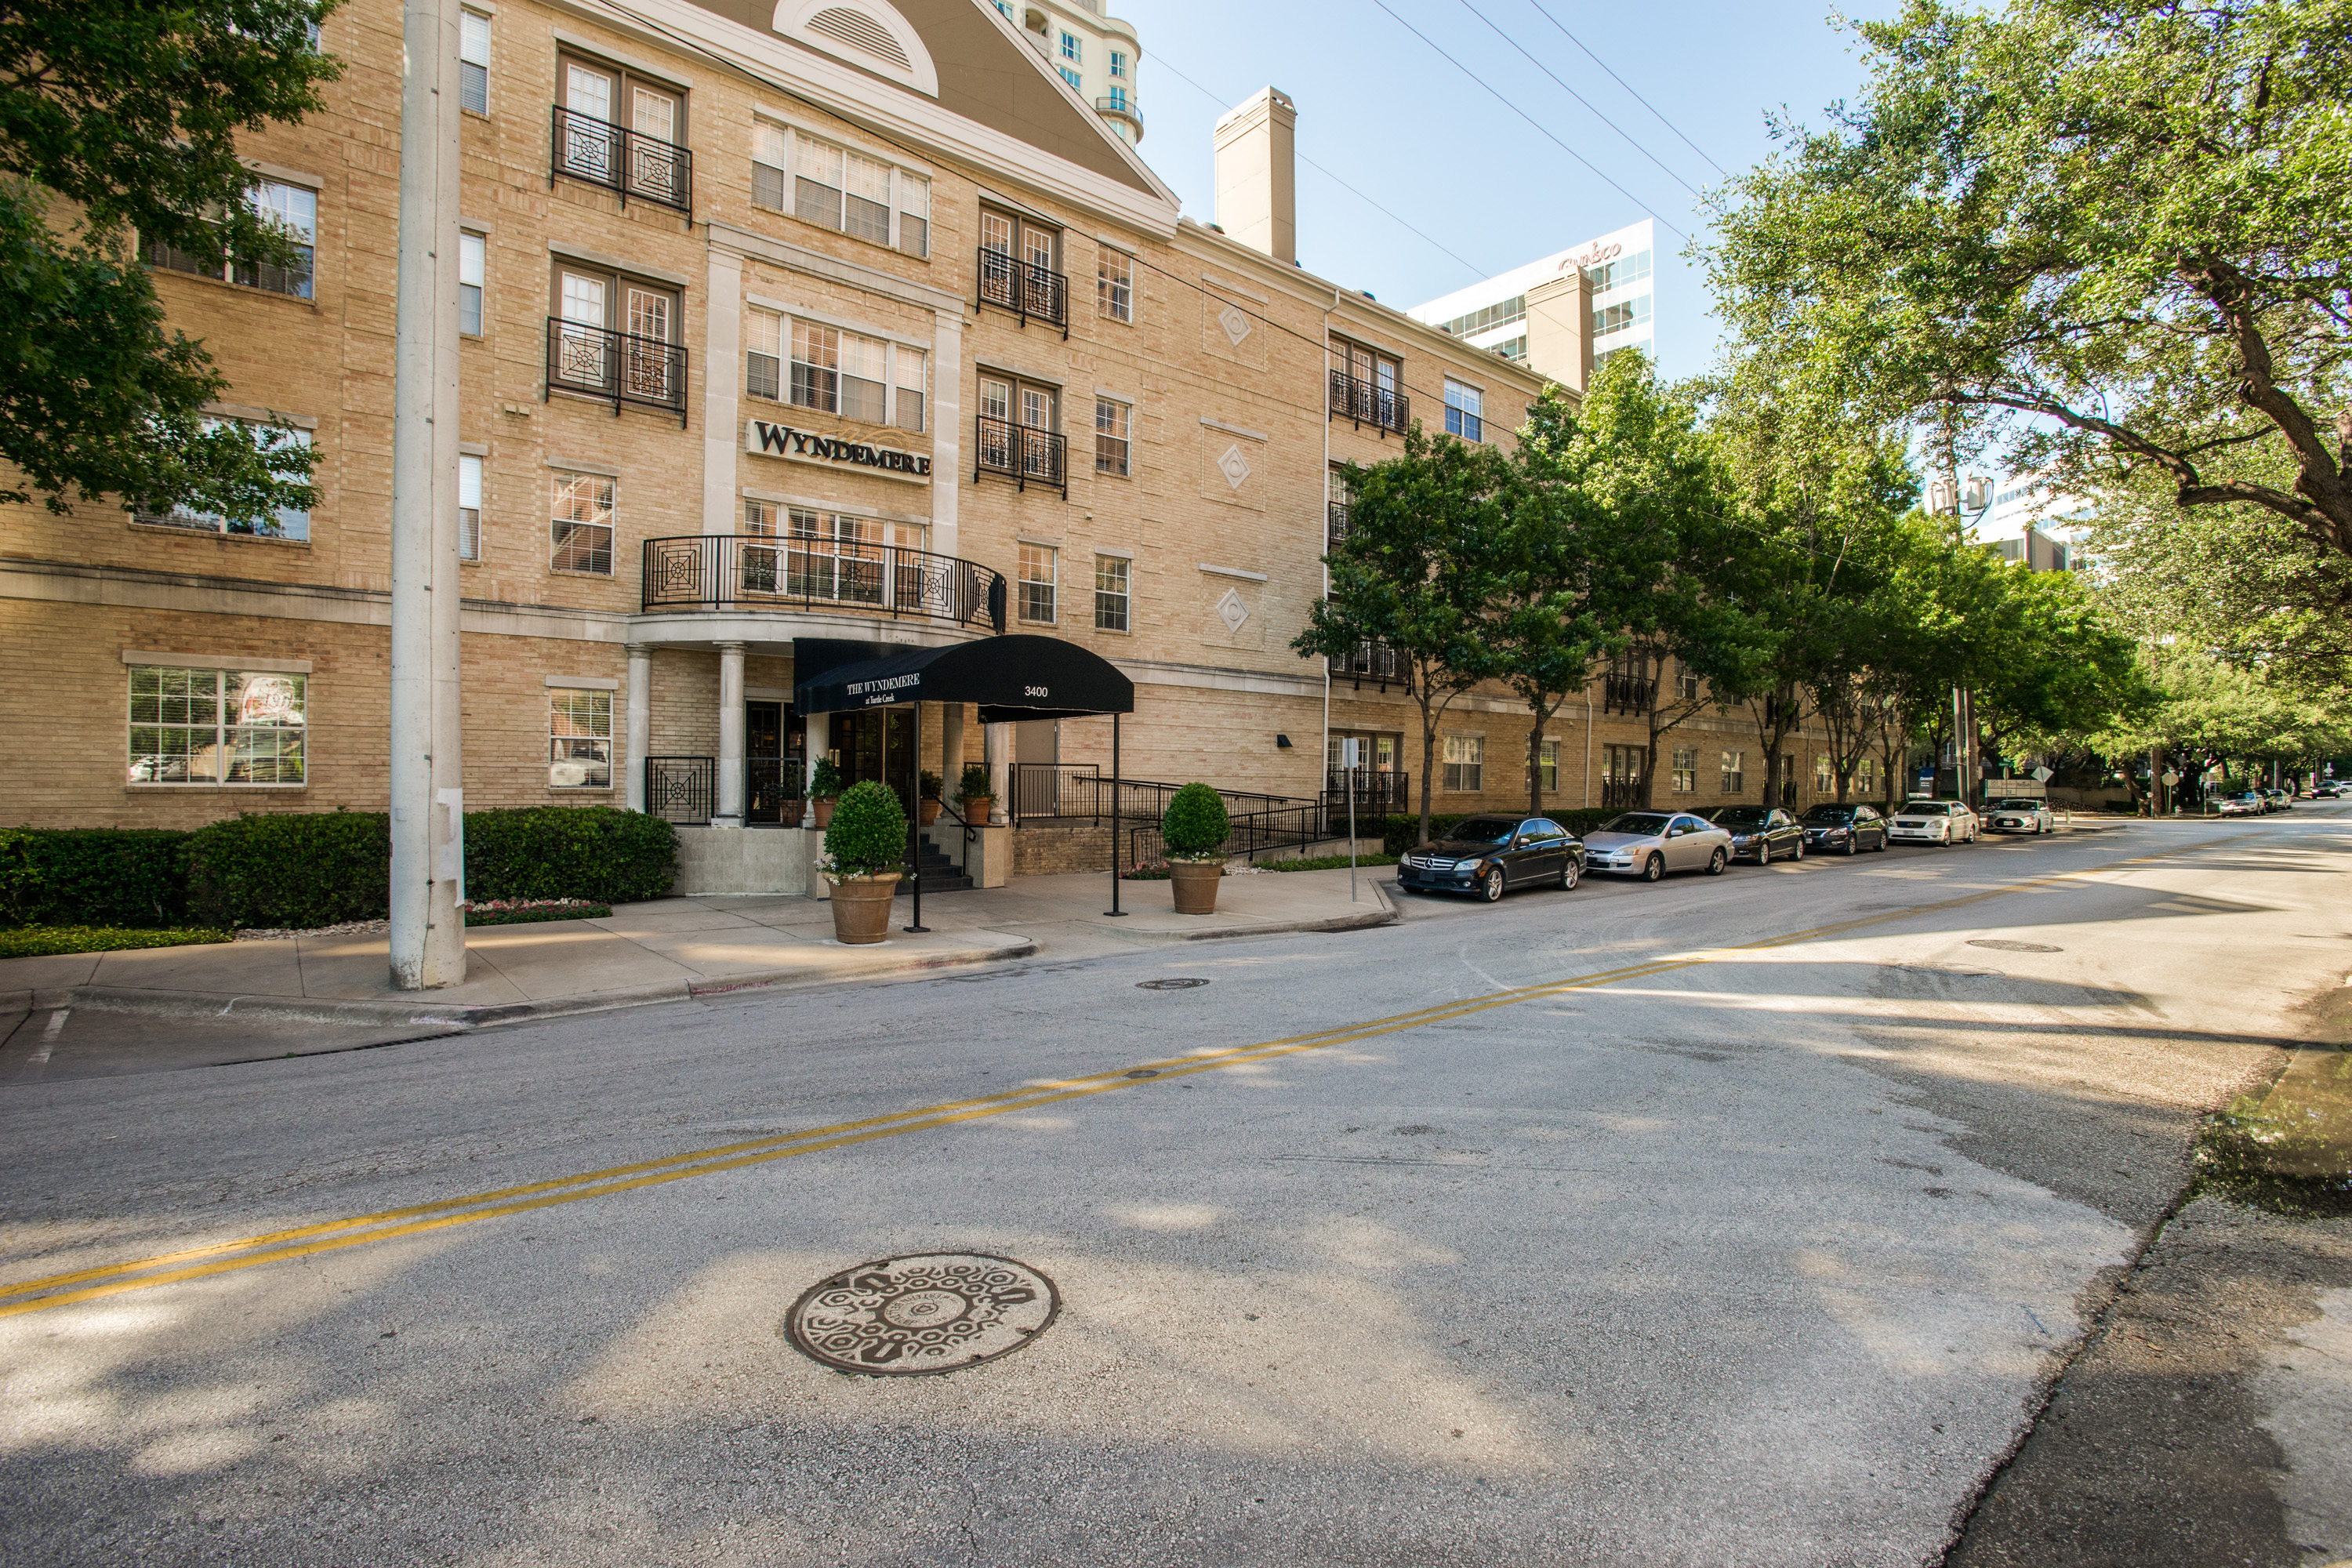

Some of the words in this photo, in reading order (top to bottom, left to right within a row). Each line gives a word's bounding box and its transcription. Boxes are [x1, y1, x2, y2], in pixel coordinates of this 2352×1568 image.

[754, 420, 931, 477] WYNDEMERE
[847, 683, 863, 695] THE
[864, 673, 920, 692] WYNDEMERE
[1025, 685, 1048, 697] 3400
[869, 695, 882, 704] Turtle
[882, 692, 895, 702] Creek
